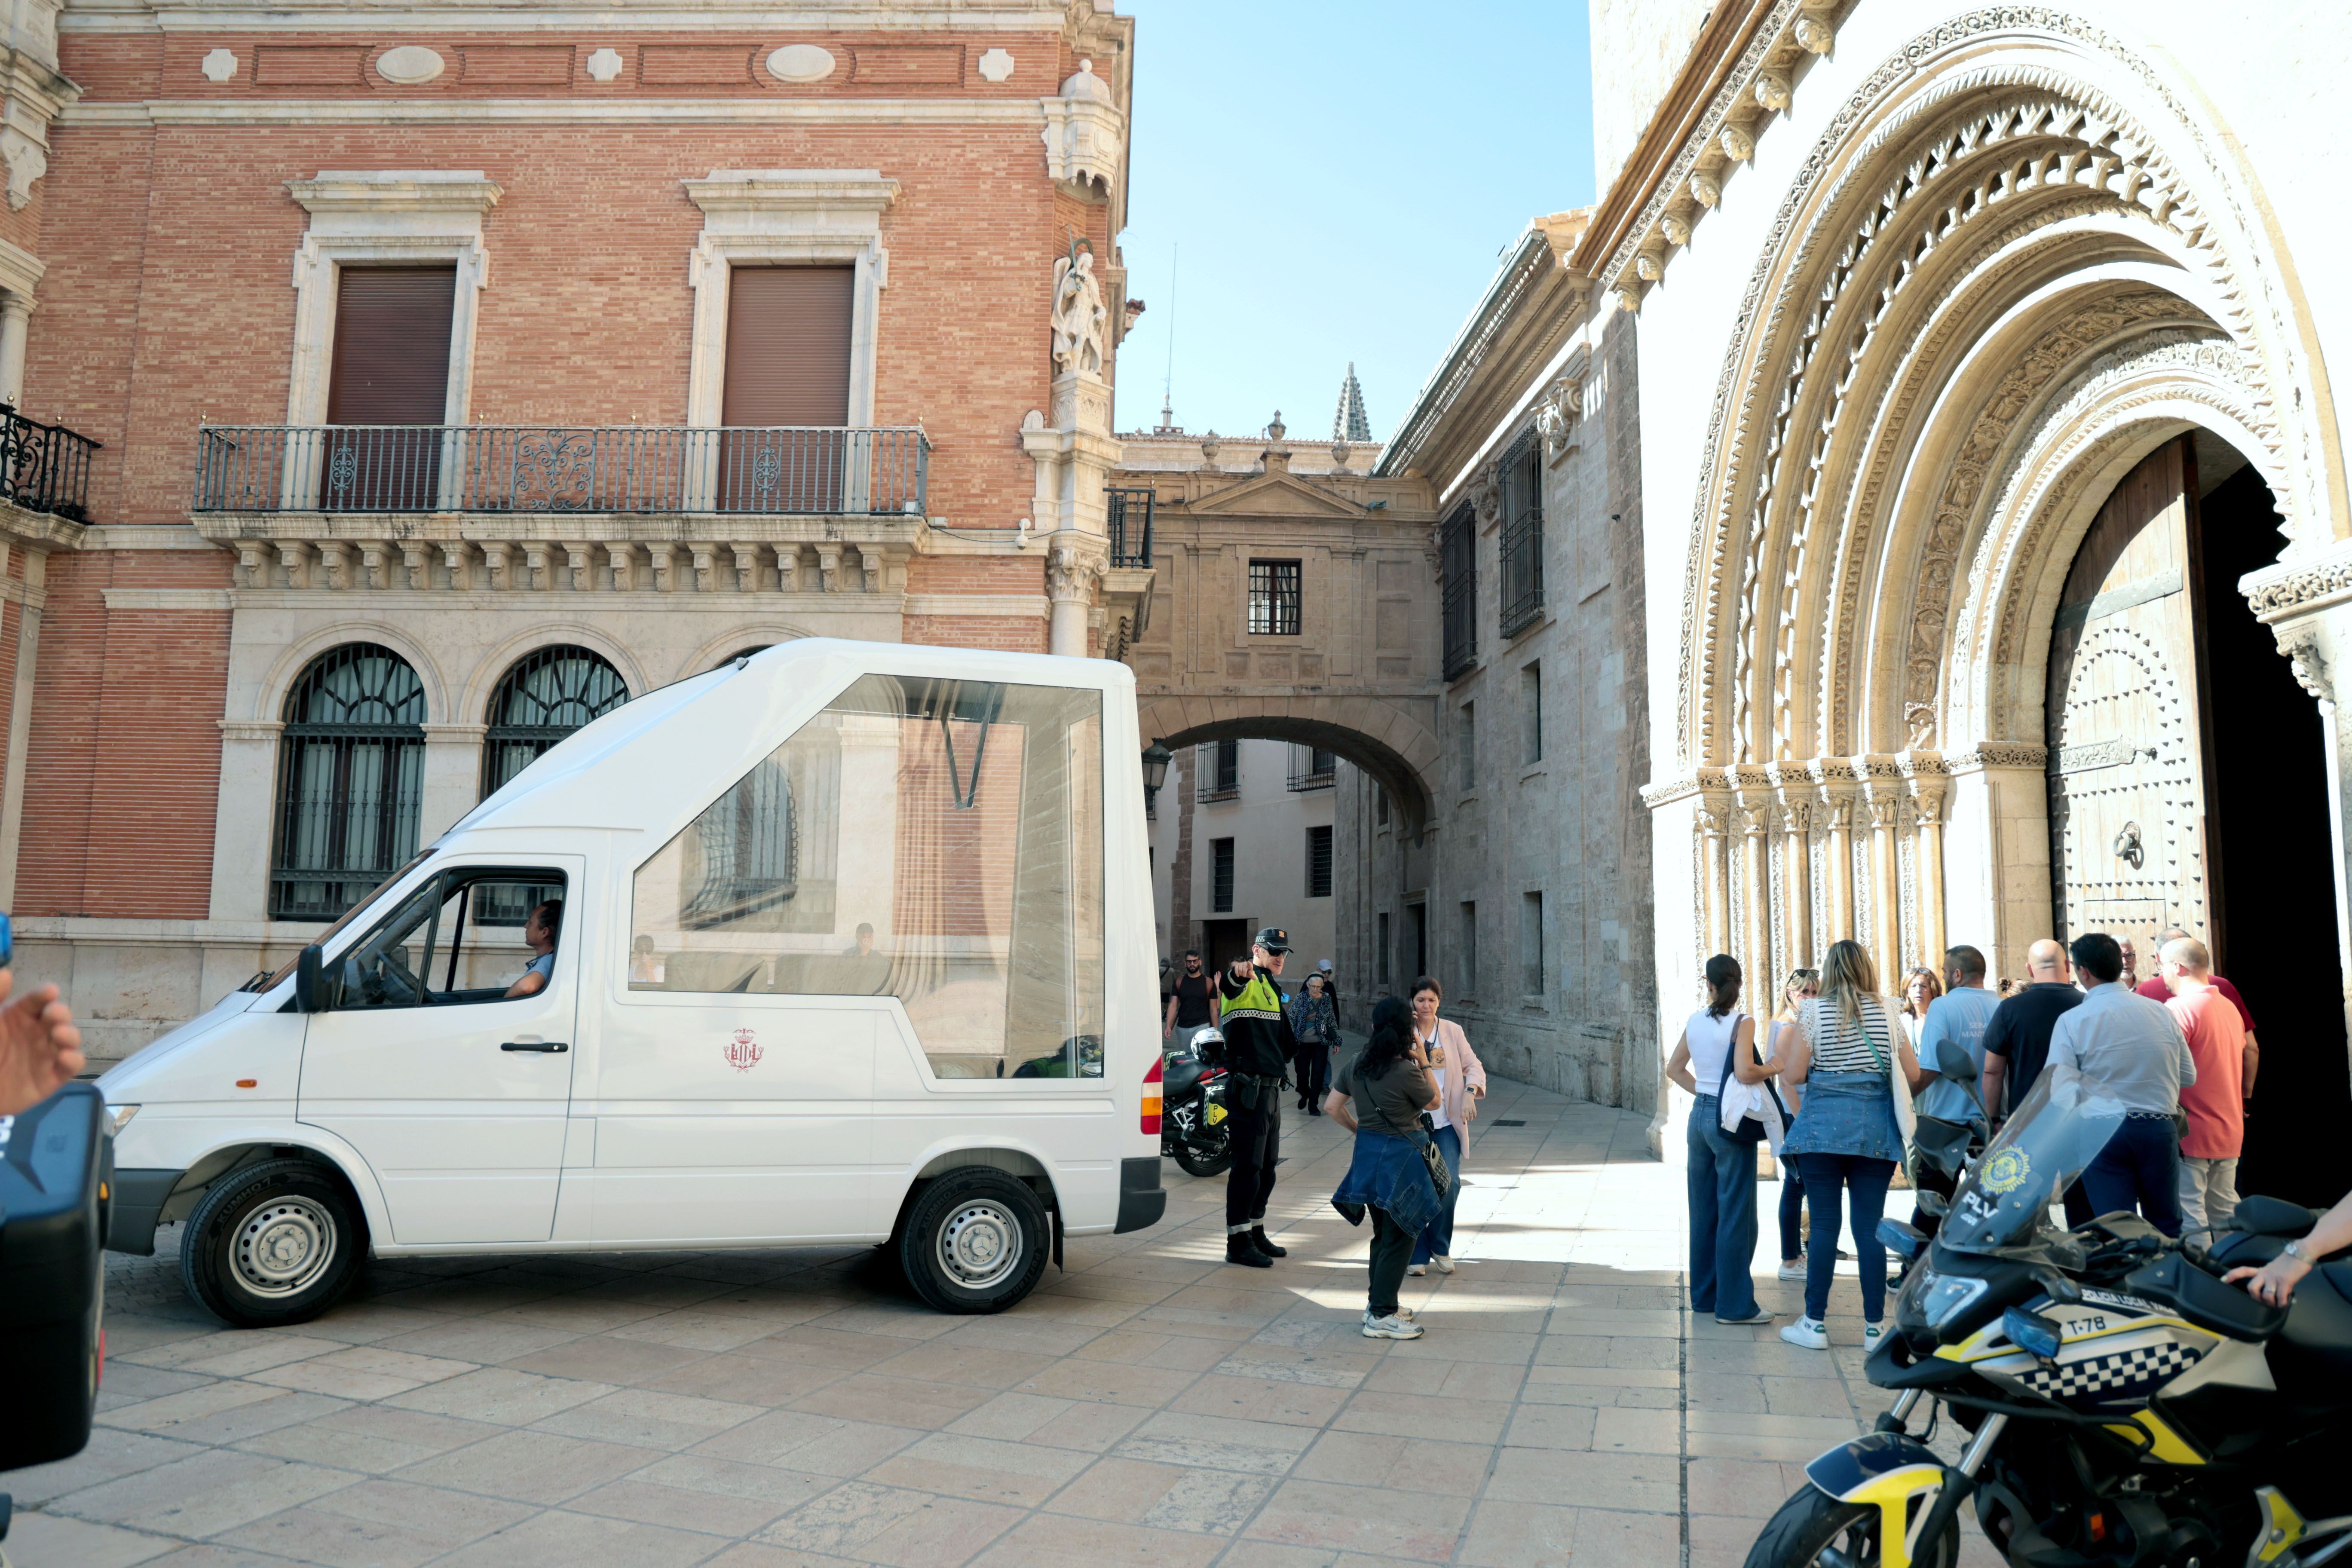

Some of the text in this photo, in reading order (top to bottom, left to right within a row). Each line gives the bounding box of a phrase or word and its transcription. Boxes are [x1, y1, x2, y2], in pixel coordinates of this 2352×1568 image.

[217, 1183, 262, 1223] KUMHO
[921, 1191, 951, 1228] KUMHO
[1962, 1190, 1999, 1219] PLV
[2081, 1289, 2120, 1304] POLICIA
[2118, 1294, 2151, 1309] LOCAL
